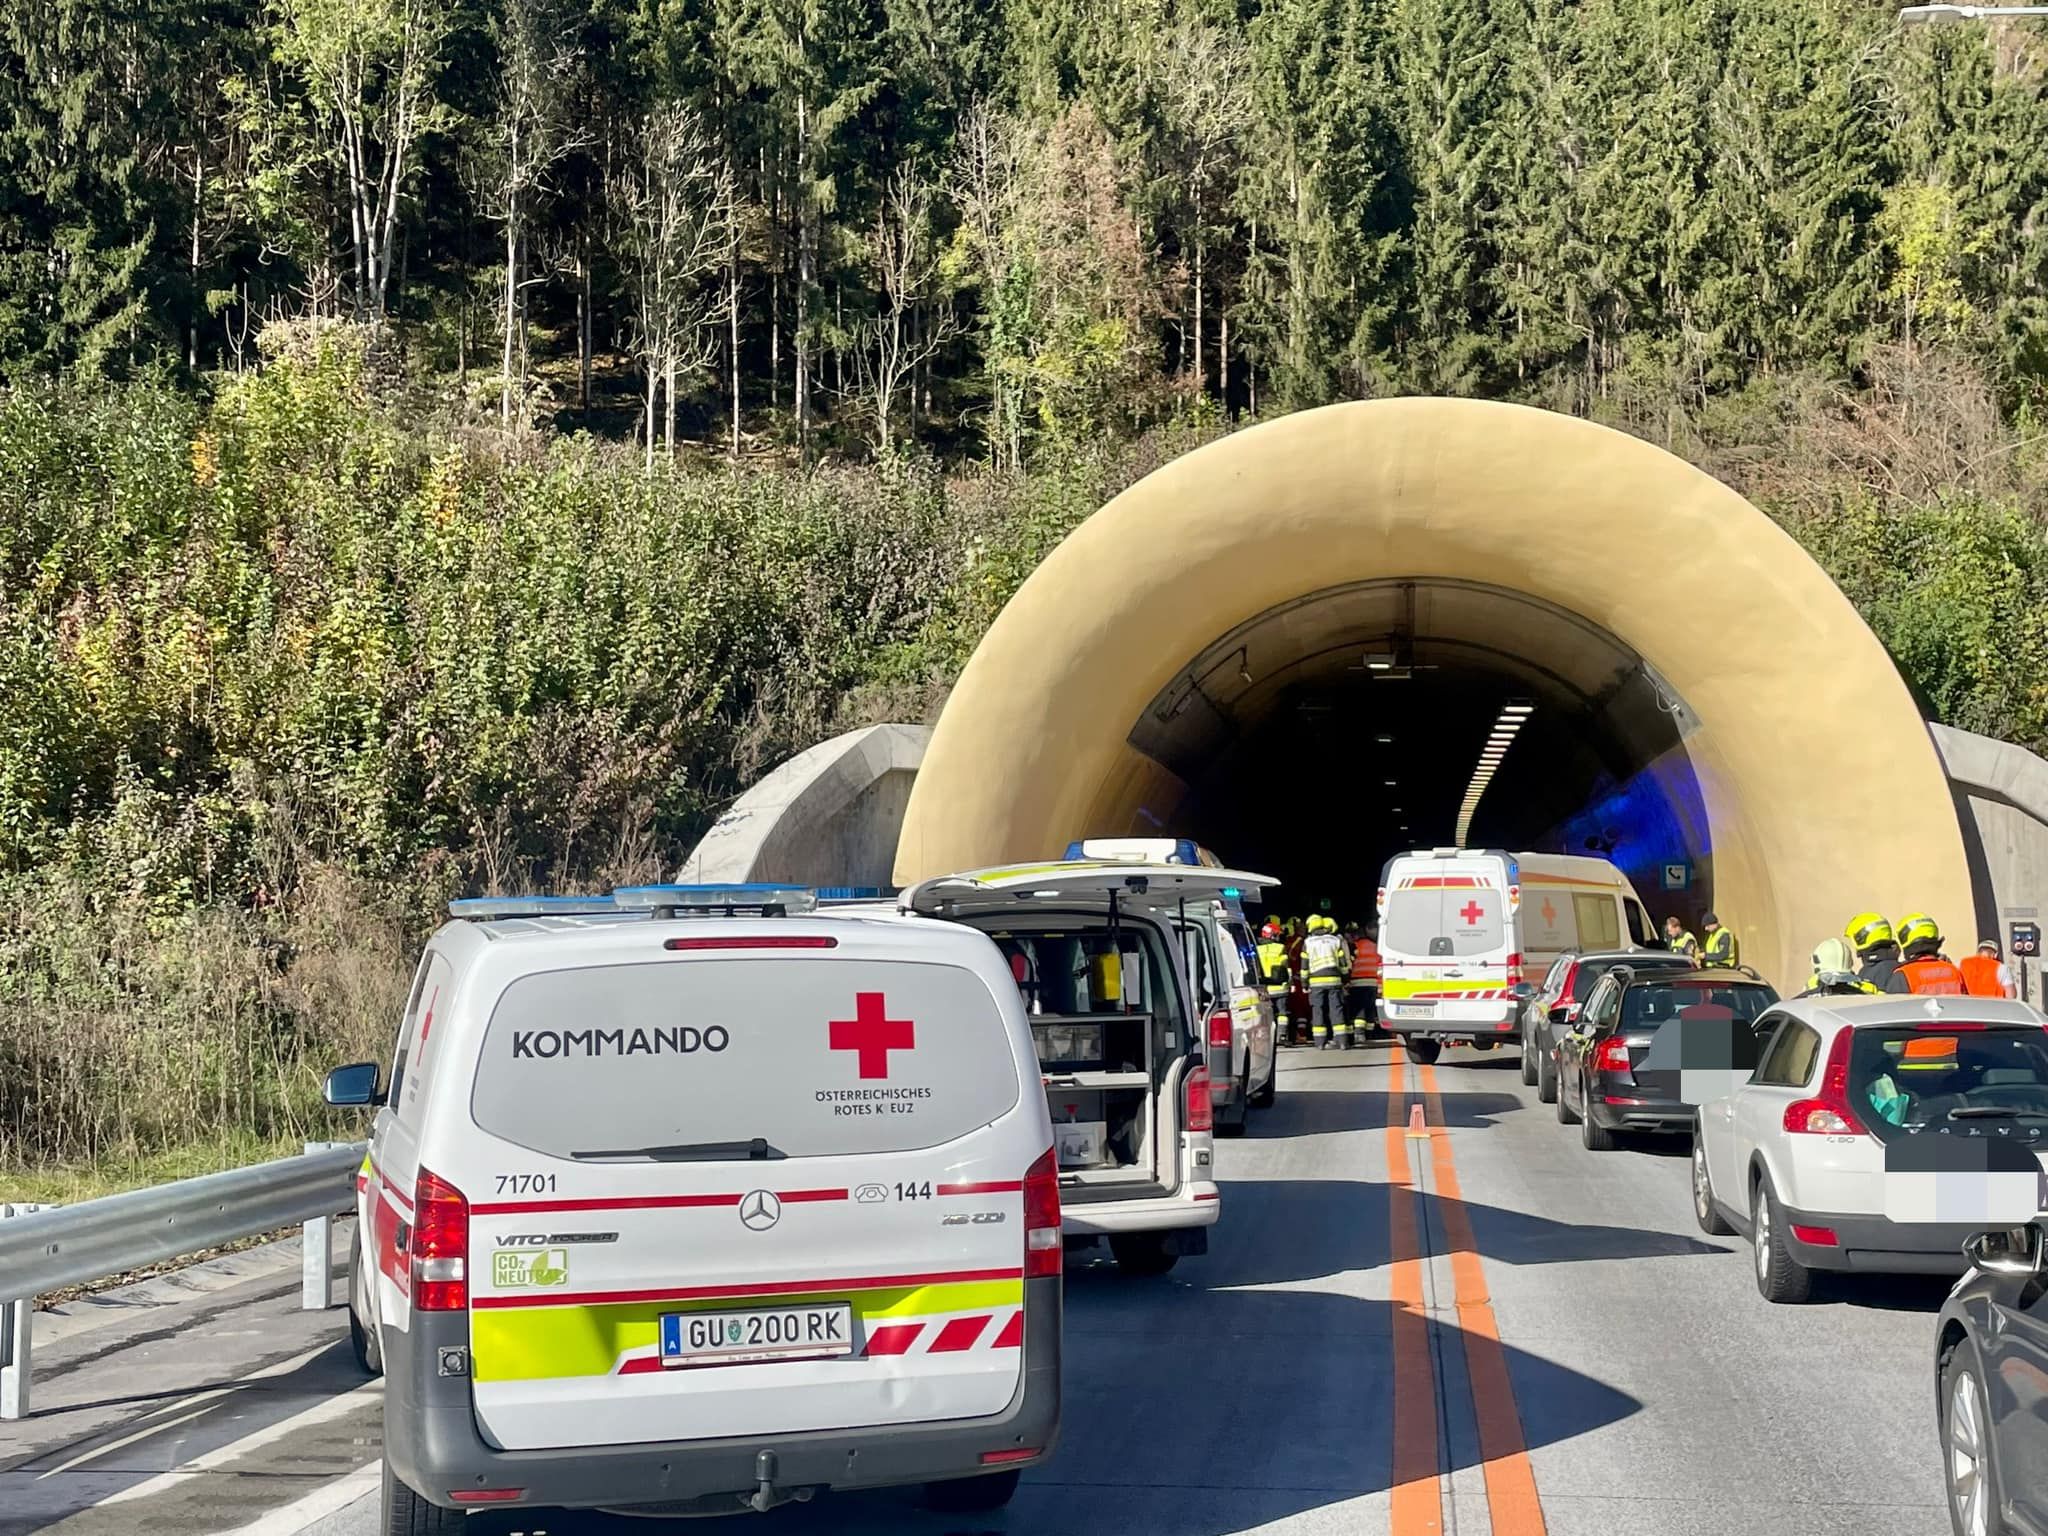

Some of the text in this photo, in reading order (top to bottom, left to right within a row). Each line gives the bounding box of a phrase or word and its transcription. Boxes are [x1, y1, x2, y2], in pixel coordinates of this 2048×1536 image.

[512, 1025, 730, 1058] KOMMANDO
[815, 1087, 932, 1102] ÖSTERREICHISCHES
[834, 1103, 914, 1116] ROTES KEUZ
[495, 1174, 556, 1195] 71701
[894, 1180, 932, 1202] 144
[495, 1234, 548, 1247] VITO
[689, 1311, 842, 1348] GU 200 RK
[668, 1340, 677, 1350] A
